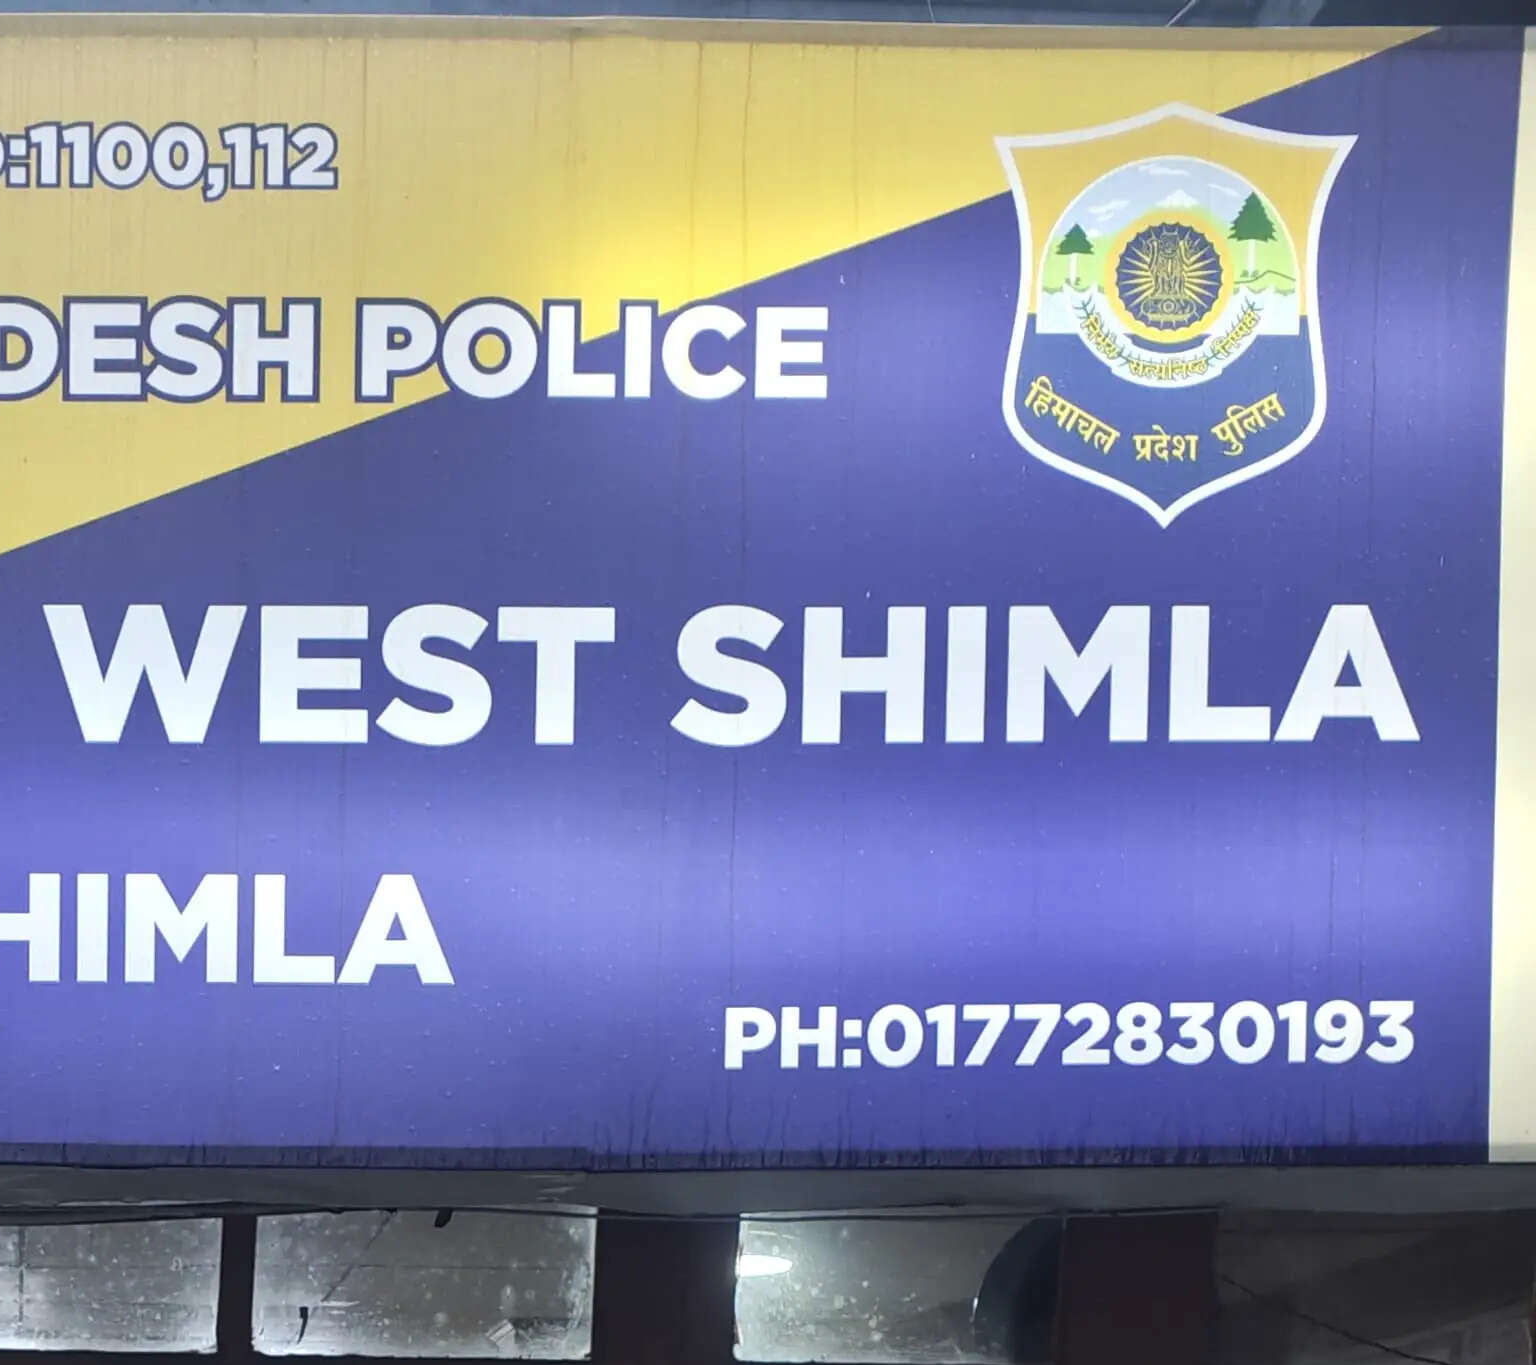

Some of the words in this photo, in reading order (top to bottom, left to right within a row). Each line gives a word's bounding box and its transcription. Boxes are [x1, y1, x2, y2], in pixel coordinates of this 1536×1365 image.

[355, 297, 829, 402] POLICE
[1024, 375, 1120, 455] हिमाचल
[1132, 425, 1198, 462] प्रदेश
[1211, 392, 1286, 456] पुलिस
[42, 602, 615, 747] WEST
[669, 603, 1421, 747] SHIMLA
[723, 999, 1415, 1070] PH:01772830193
